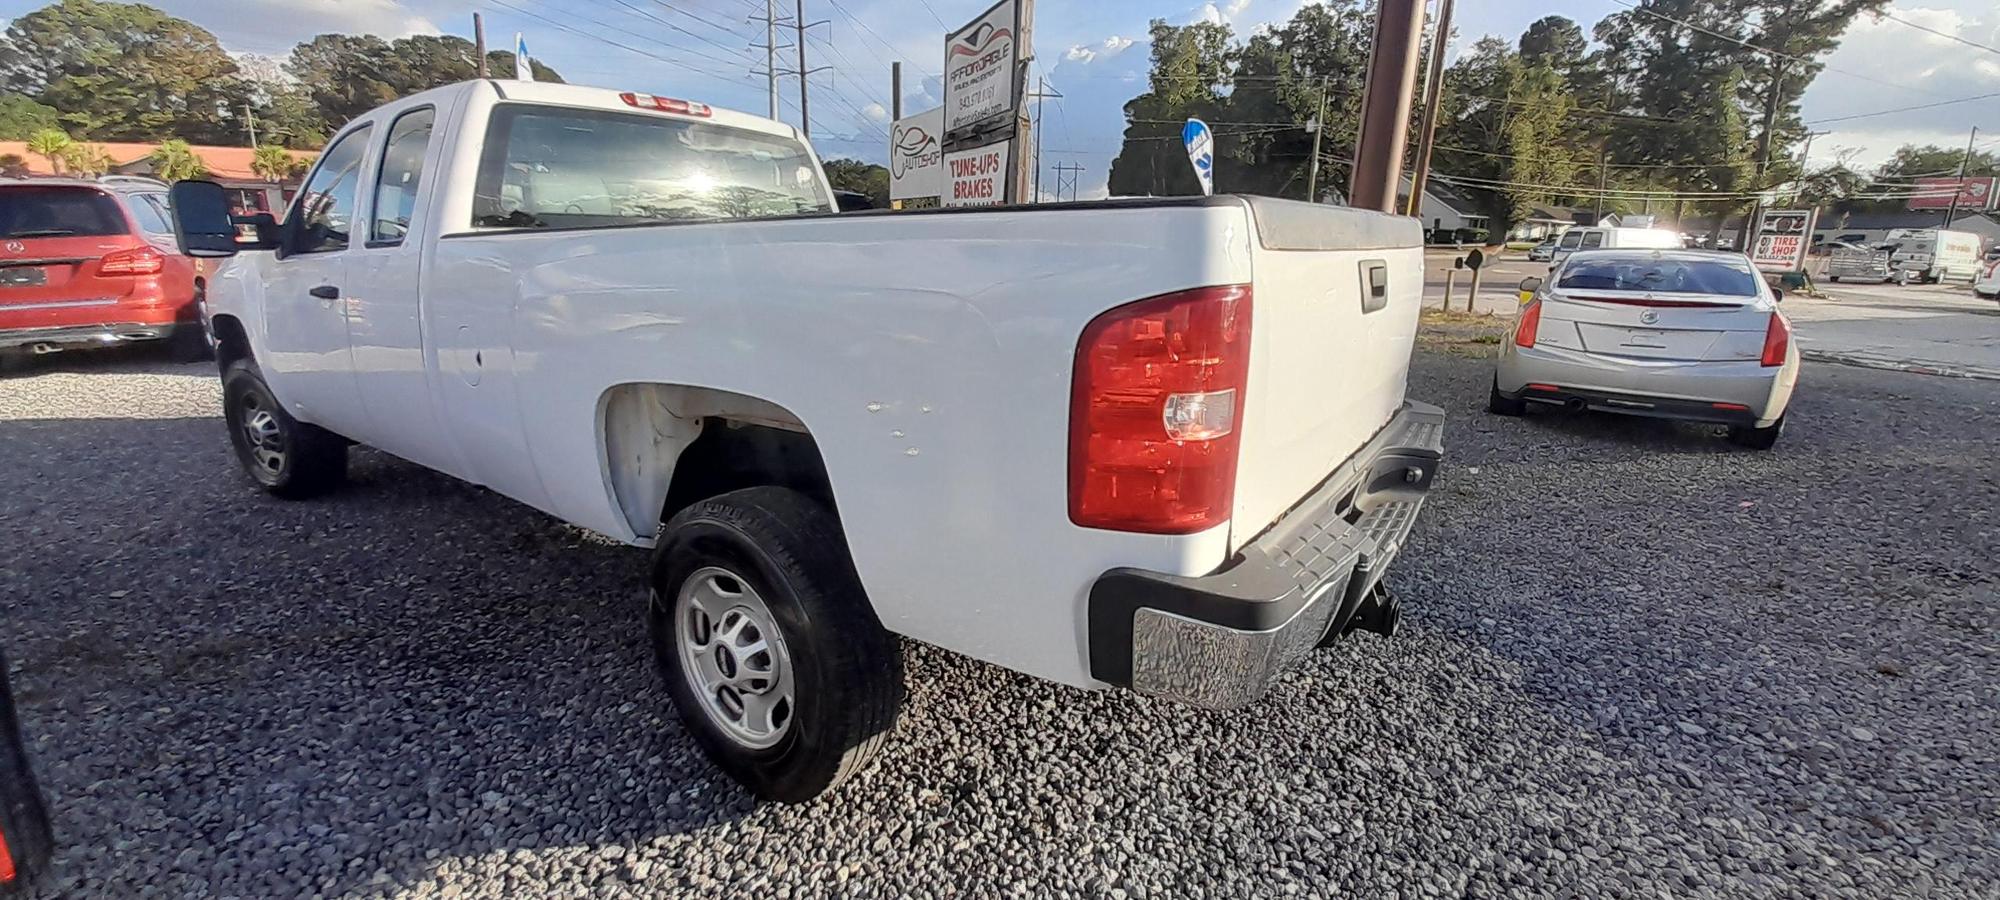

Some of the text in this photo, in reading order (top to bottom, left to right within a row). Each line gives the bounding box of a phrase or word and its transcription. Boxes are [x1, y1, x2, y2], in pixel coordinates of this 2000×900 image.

[950, 42, 1010, 83] AFFORDABLE
[949, 152, 1000, 178] TUNE-UPS
[953, 178, 993, 200] BRAKES
[1771, 246, 1797, 255] SHOP
[1774, 237, 1799, 246] TIRES
